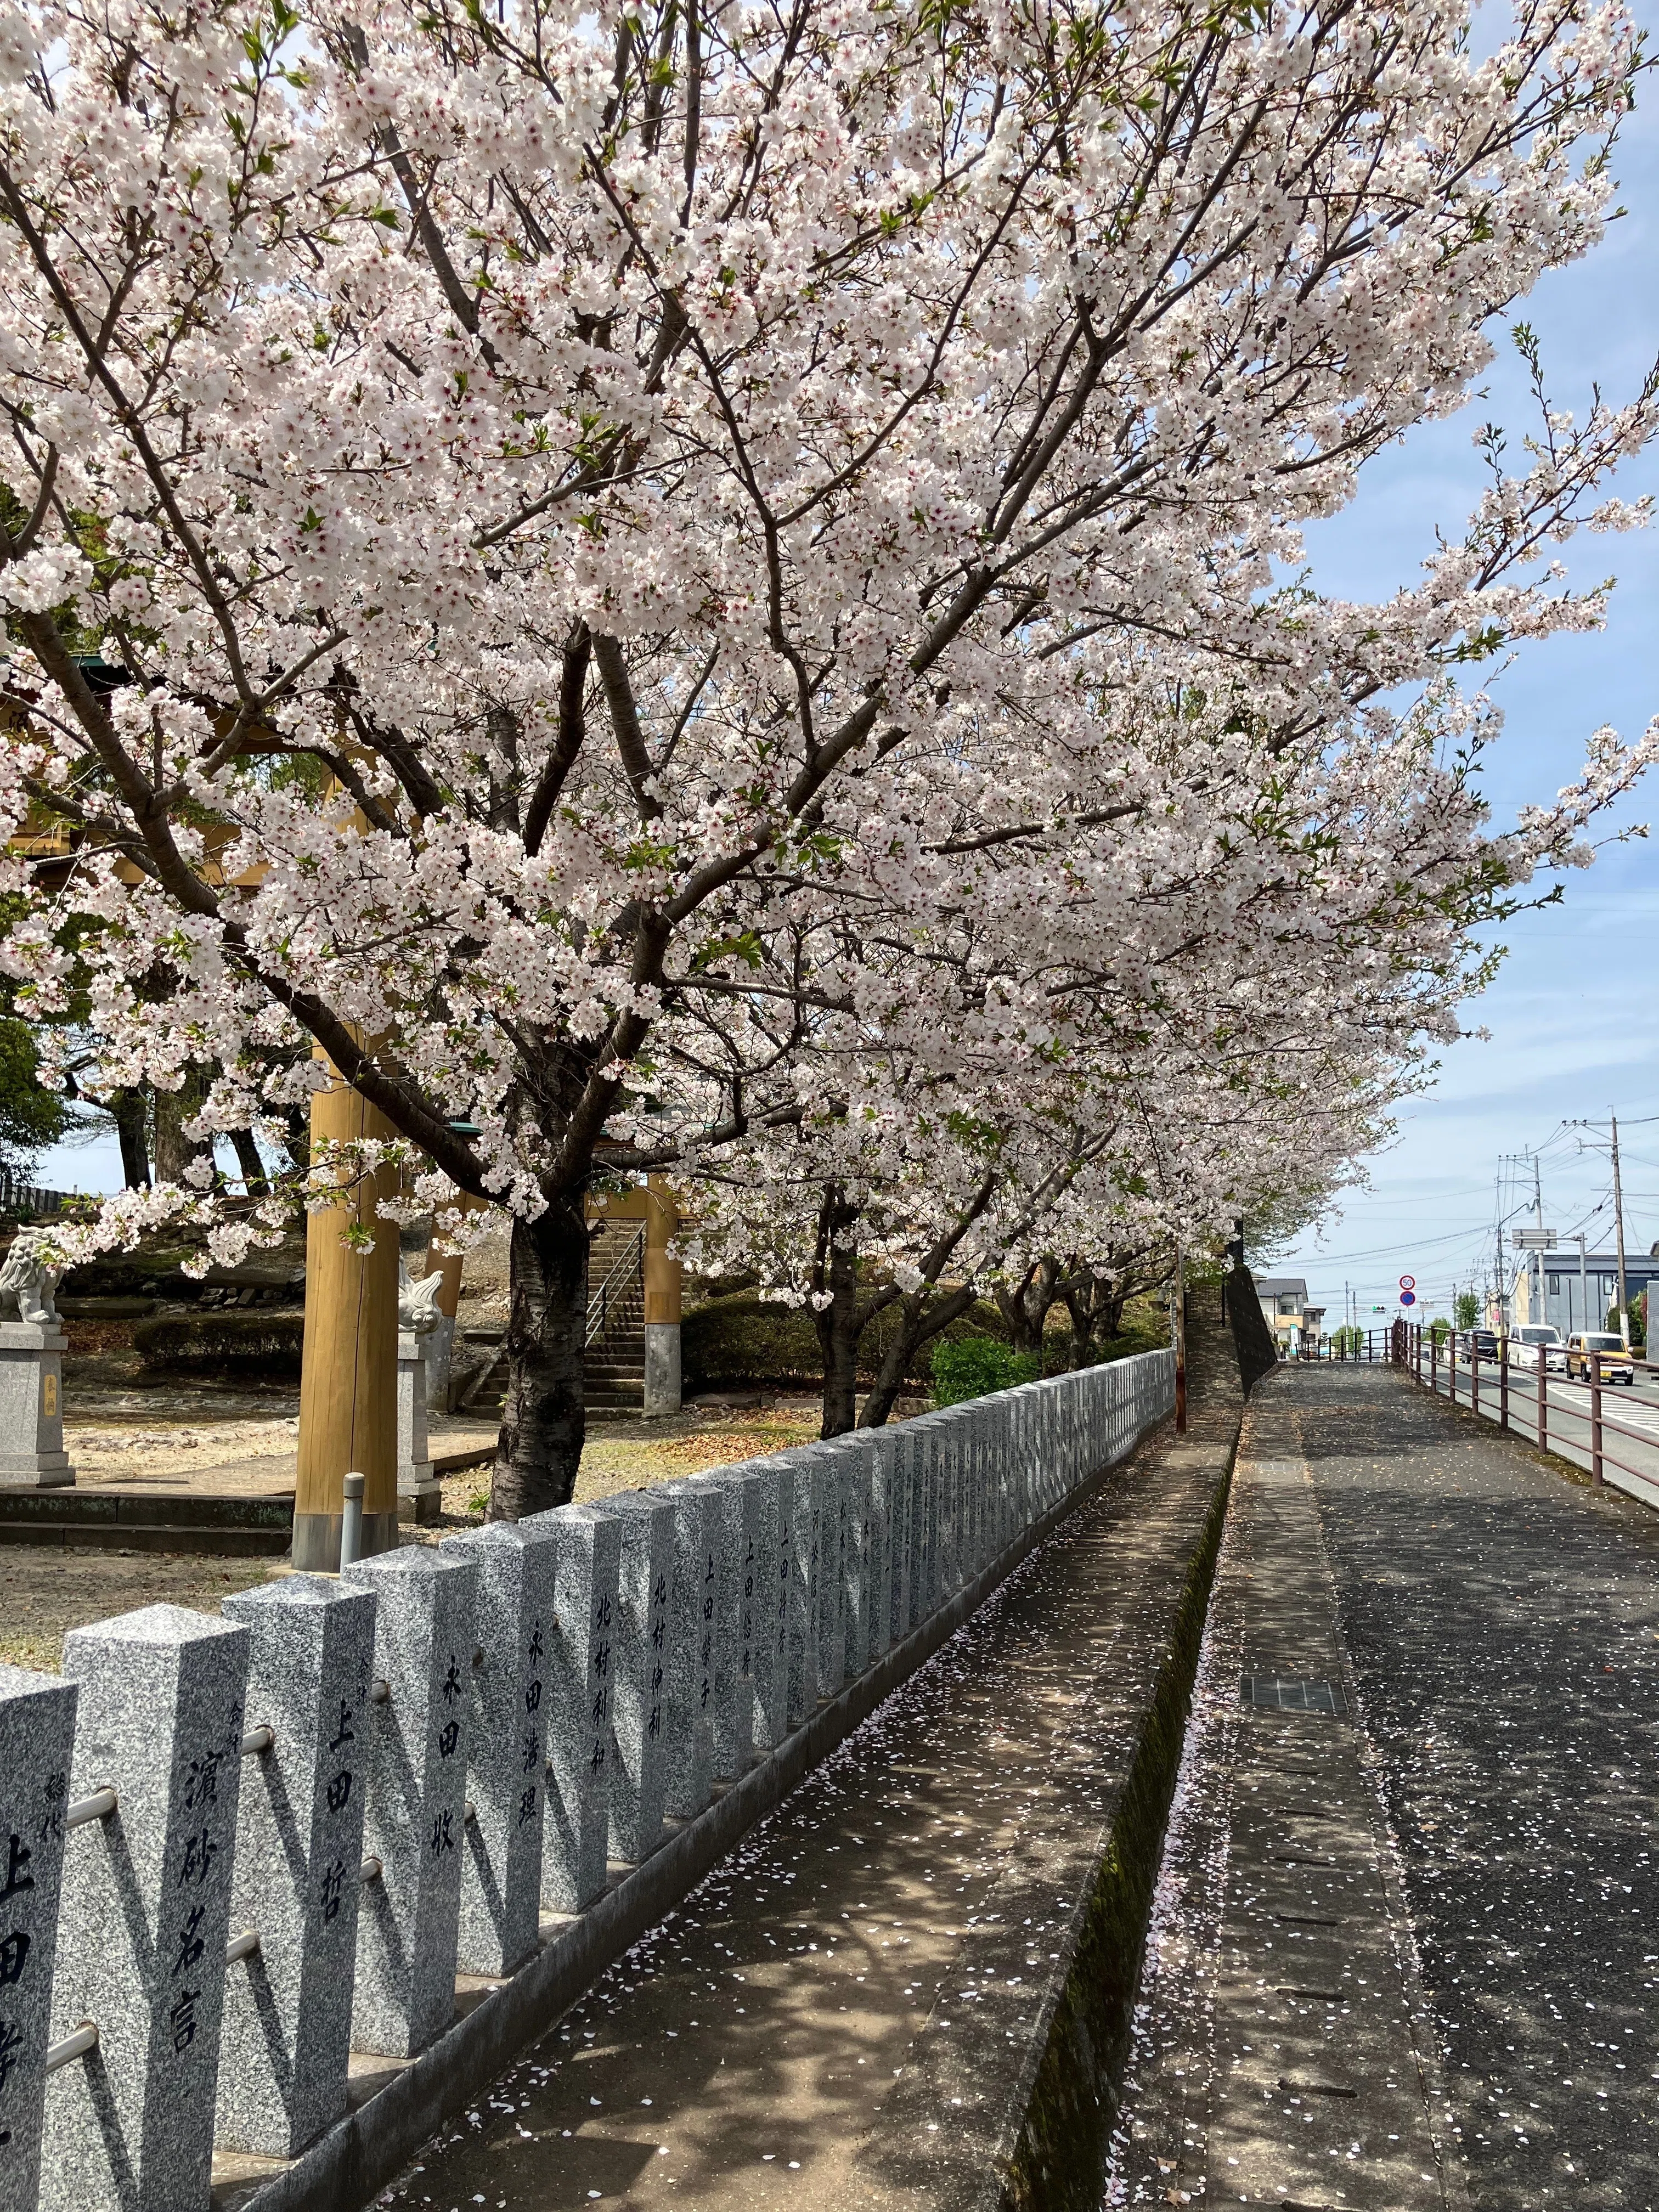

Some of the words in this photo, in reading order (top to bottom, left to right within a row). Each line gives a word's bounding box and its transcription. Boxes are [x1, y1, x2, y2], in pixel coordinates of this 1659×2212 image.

[225, 1701, 242, 1756] 会計
[357, 1657, 369, 1703] 会計
[591, 1592, 611, 1776] 北村利和
[648, 1572, 667, 1742] 北村伸利
[320, 1699, 355, 1926] 上田哲
